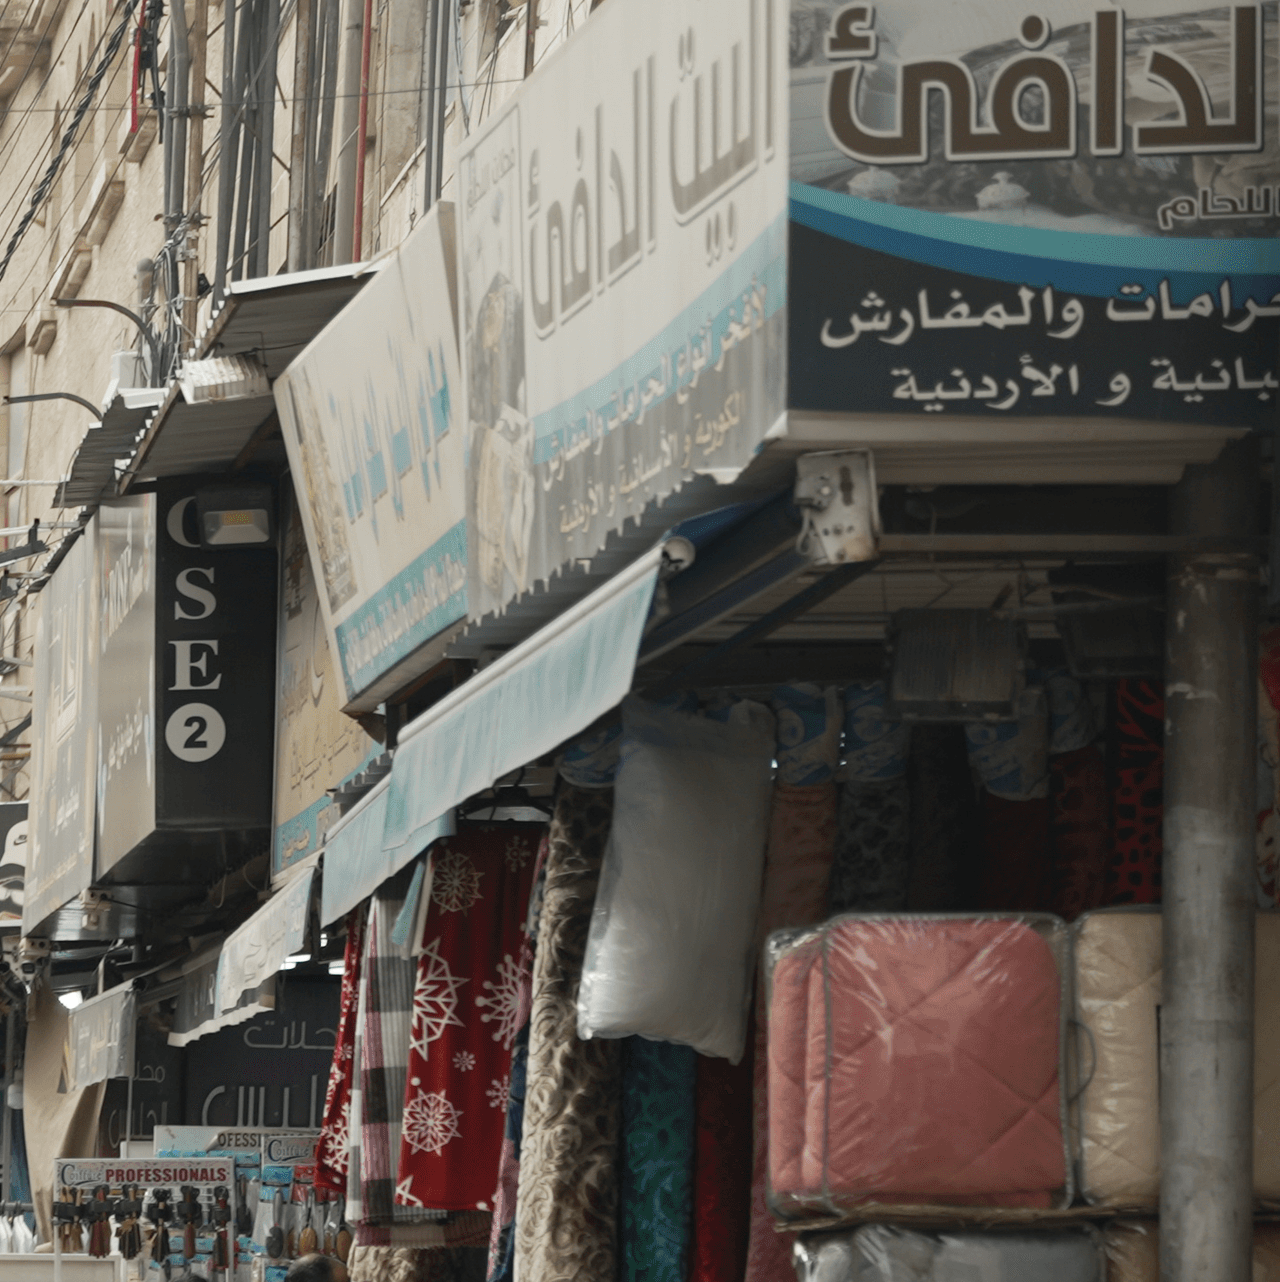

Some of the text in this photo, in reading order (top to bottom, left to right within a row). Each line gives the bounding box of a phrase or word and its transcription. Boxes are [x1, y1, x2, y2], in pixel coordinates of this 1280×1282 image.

[825, 3, 1266, 164] لدافئ
[527, 50, 657, 342] الدافئ
[820, 284, 1086, 350] والمفارش
[890, 354, 1080, 412] الأردنية
[1095, 370, 1133, 407] و
[244, 1020, 338, 1050] حلات
[105, 1167, 228, 1183] PROFESSIONALS
